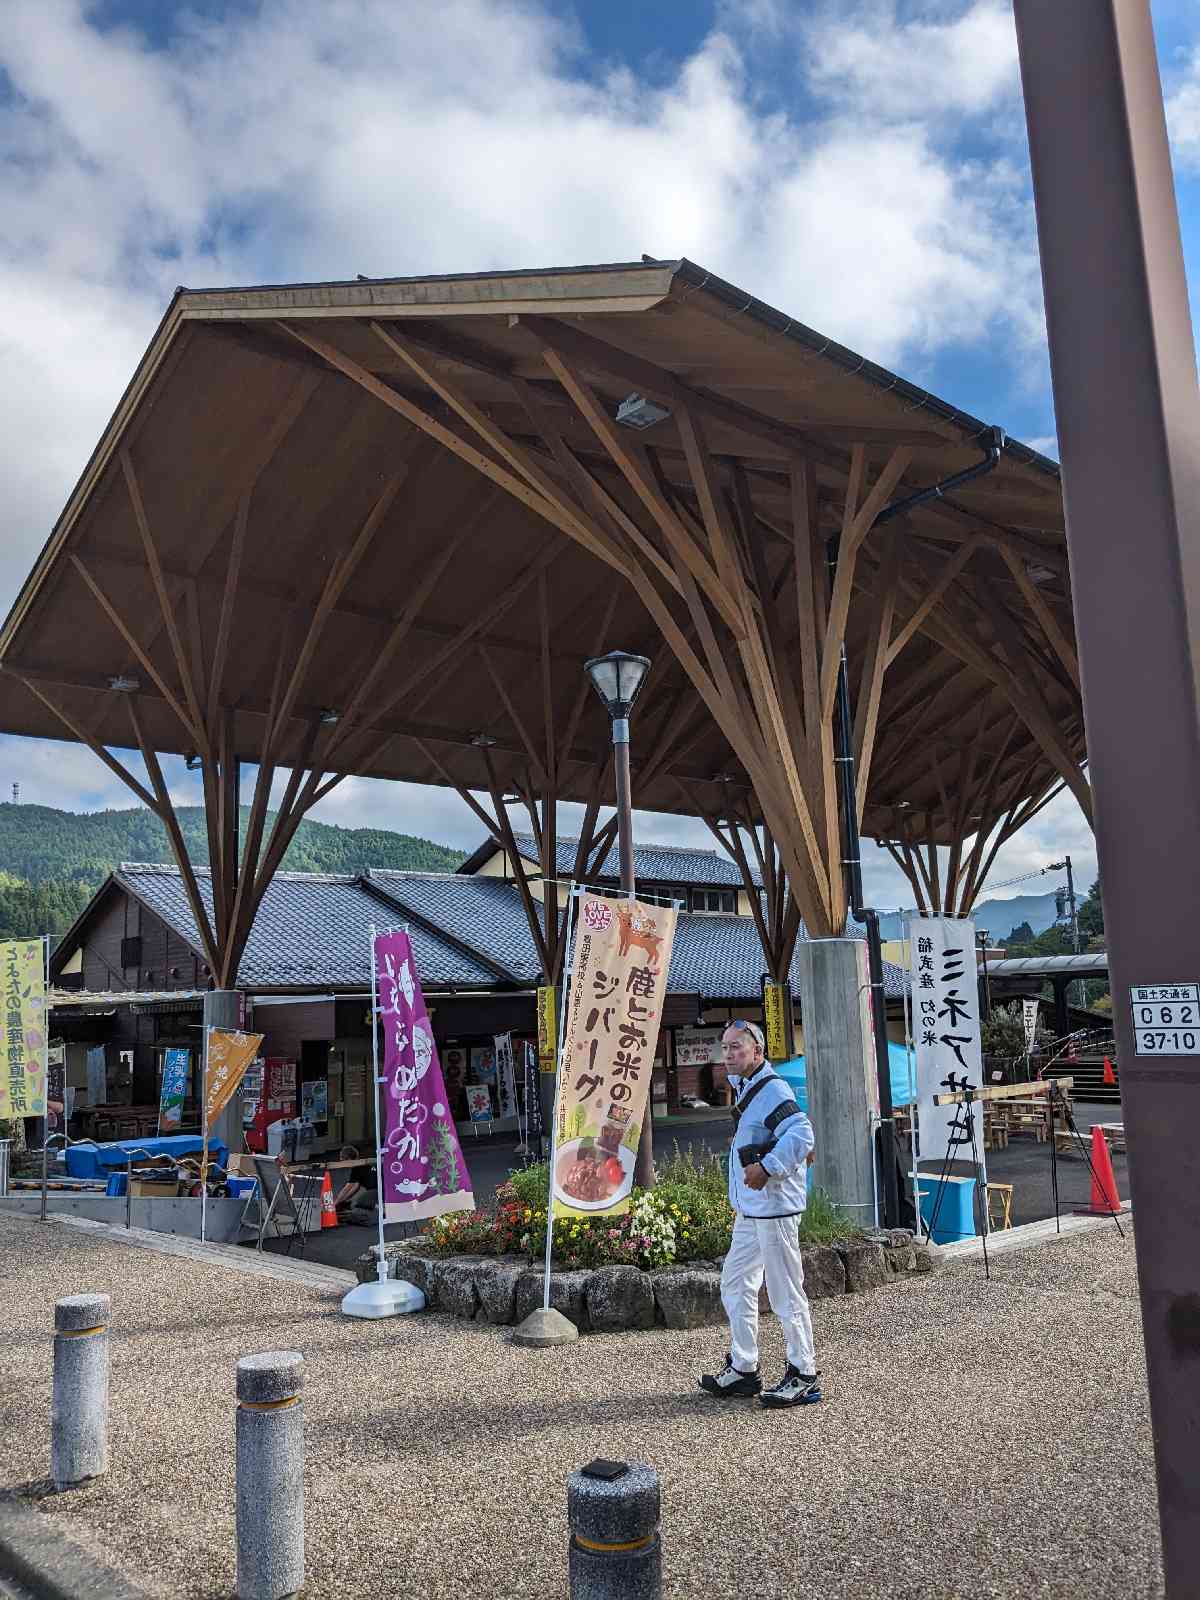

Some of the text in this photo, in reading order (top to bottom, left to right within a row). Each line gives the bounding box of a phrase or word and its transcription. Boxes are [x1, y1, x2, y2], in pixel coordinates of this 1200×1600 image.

[583, 911, 612, 920] LOVE
[1138, 989, 1190, 1000] 国土交通省
[575, 970, 619, 1102] ジバーグ
[610, 966, 656, 1102] 鹿とお米の
[1143, 1032, 1196, 1050] 37-10
